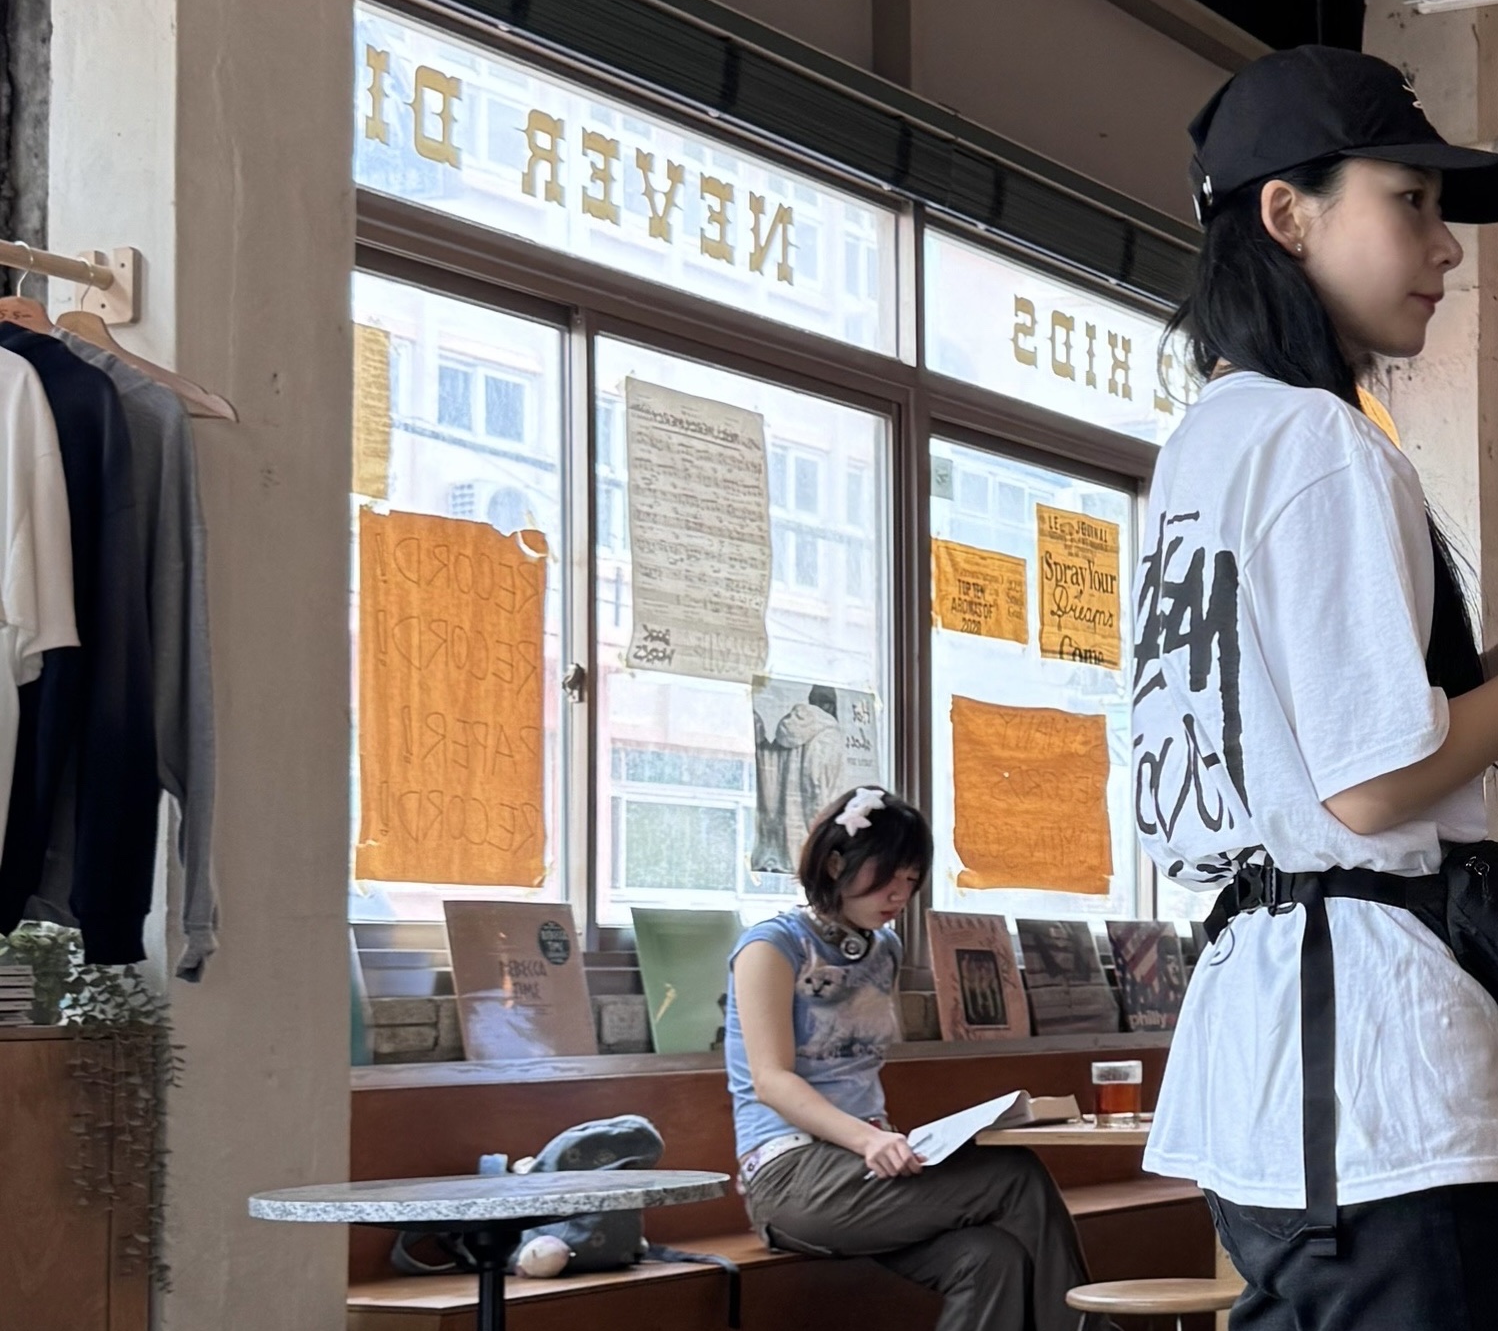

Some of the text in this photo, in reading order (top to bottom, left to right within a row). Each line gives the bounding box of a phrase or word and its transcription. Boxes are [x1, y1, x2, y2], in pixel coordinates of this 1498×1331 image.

[1044, 550, 1089, 590] Spray
[1087, 558, 1117, 595] Your
[1050, 585, 1115, 633] Dreams
